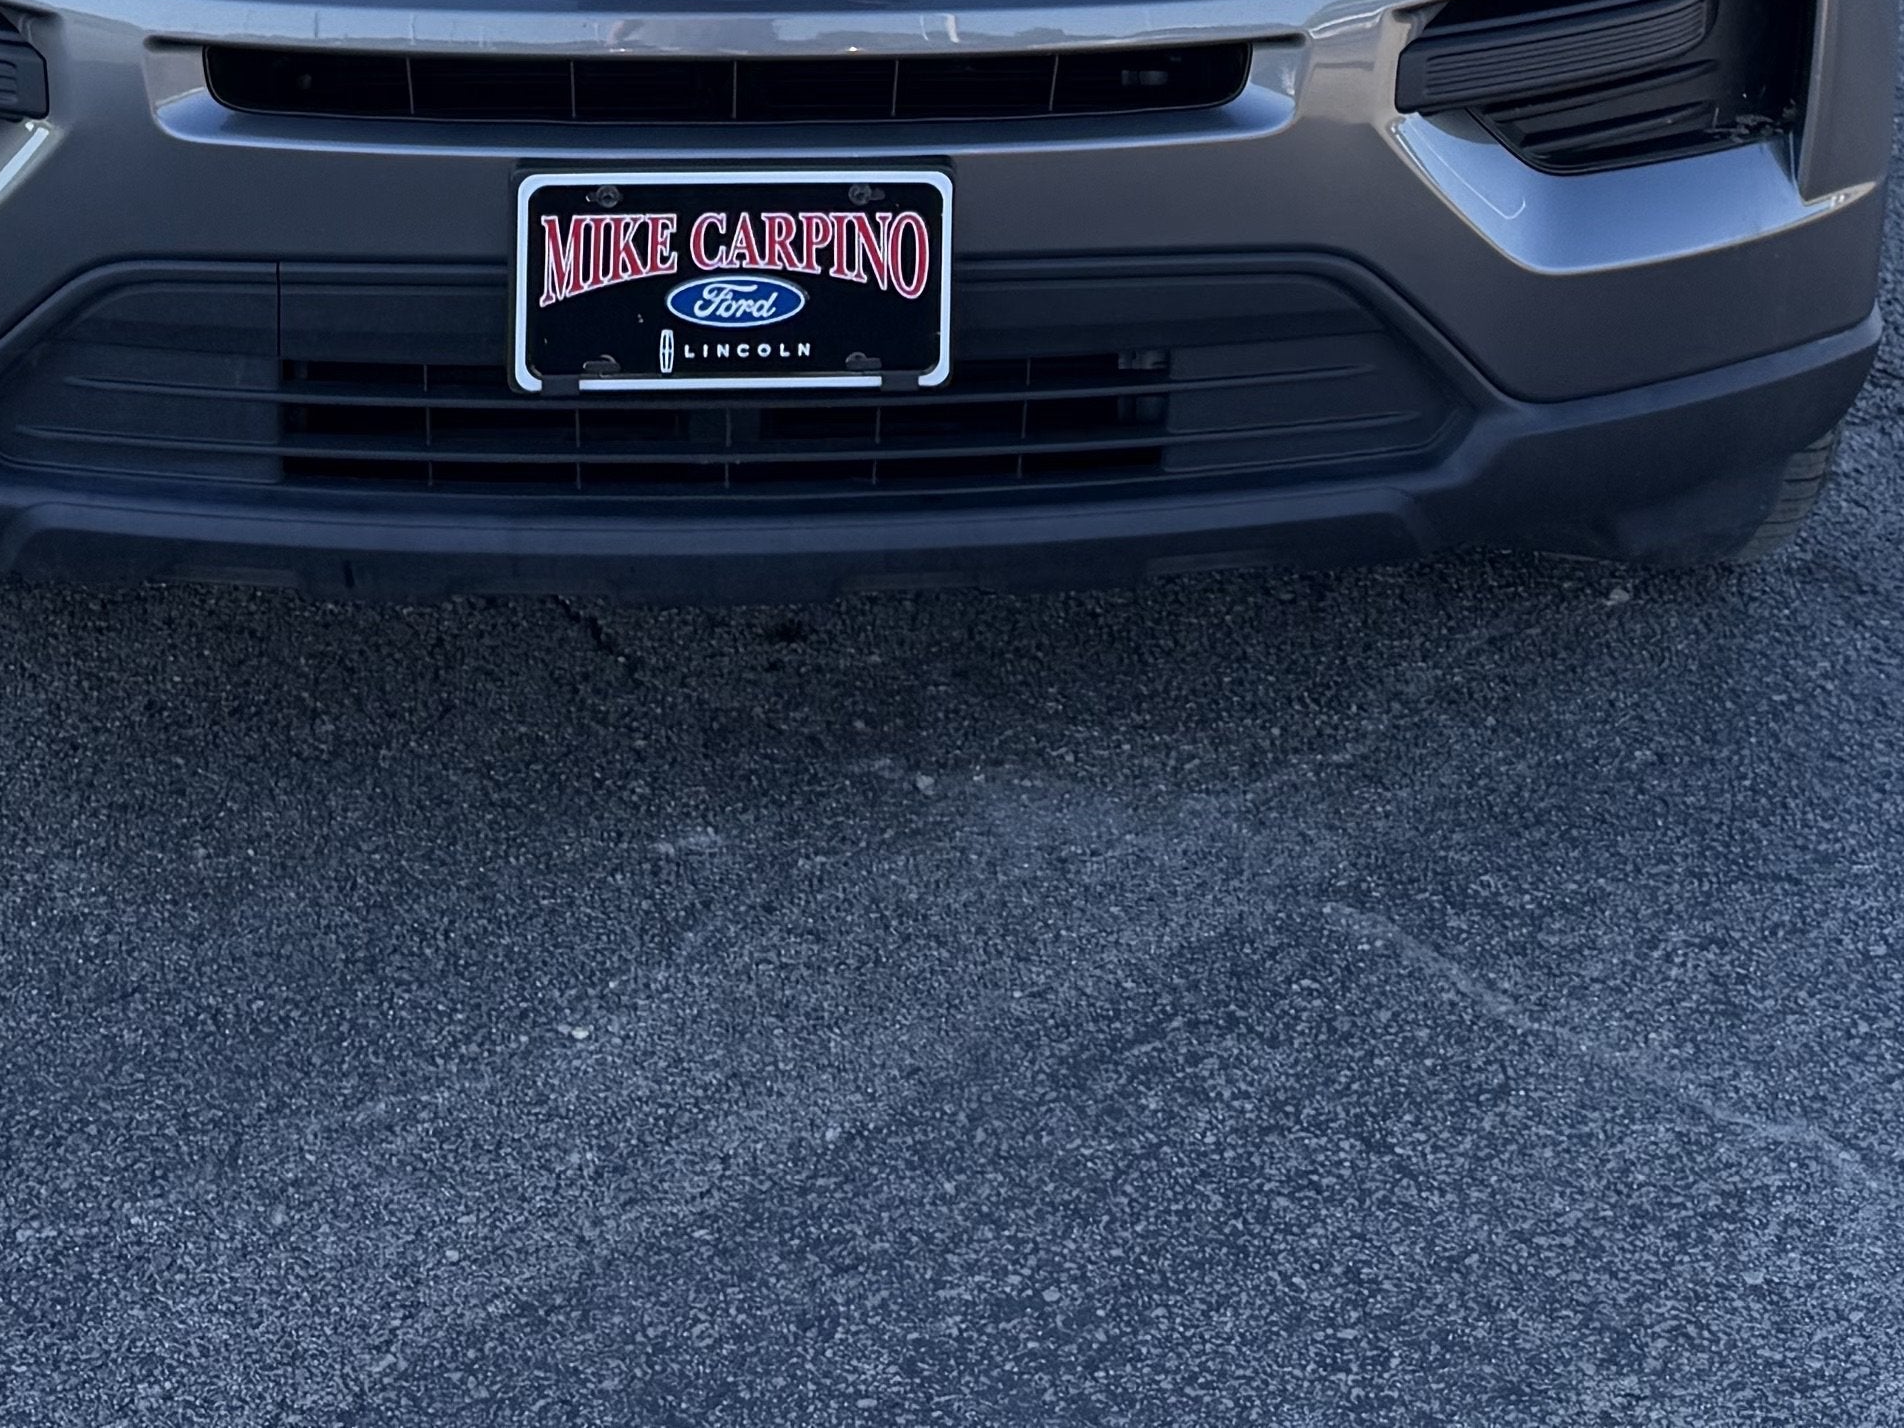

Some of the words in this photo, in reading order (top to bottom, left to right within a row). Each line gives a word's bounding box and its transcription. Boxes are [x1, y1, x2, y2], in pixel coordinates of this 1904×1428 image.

[539, 212, 679, 308] MIKE
[689, 210, 930, 300] CARPINO
[692, 279, 778, 320] Ford
[683, 341, 812, 359] LINCOLN
